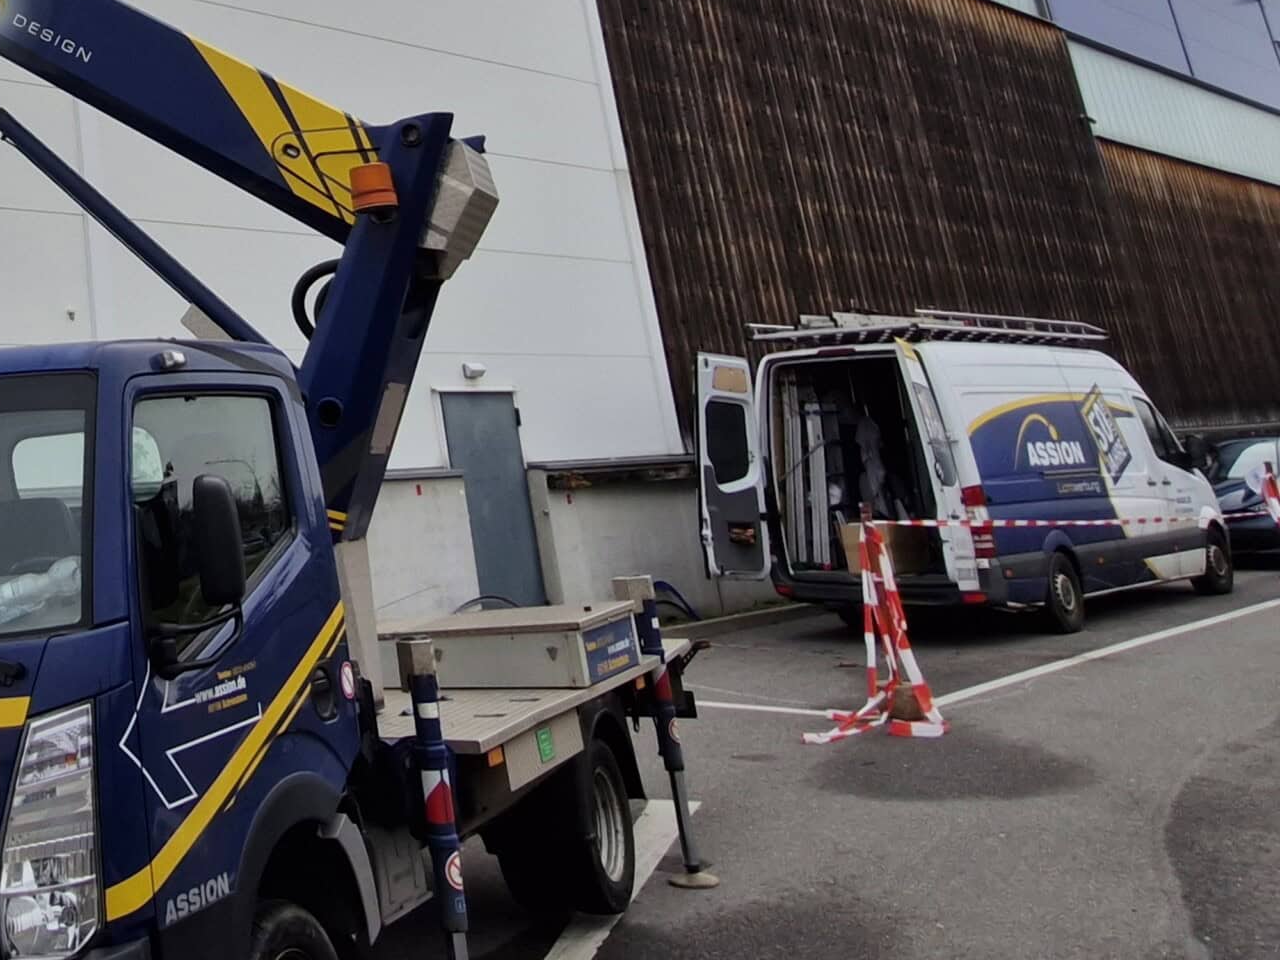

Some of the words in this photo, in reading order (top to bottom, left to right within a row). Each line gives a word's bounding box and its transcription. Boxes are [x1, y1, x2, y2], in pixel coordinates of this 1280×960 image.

[13, 14, 92, 63] DESIGN
[1027, 441, 1086, 466] ASSION
[165, 871, 230, 927] ASSION
